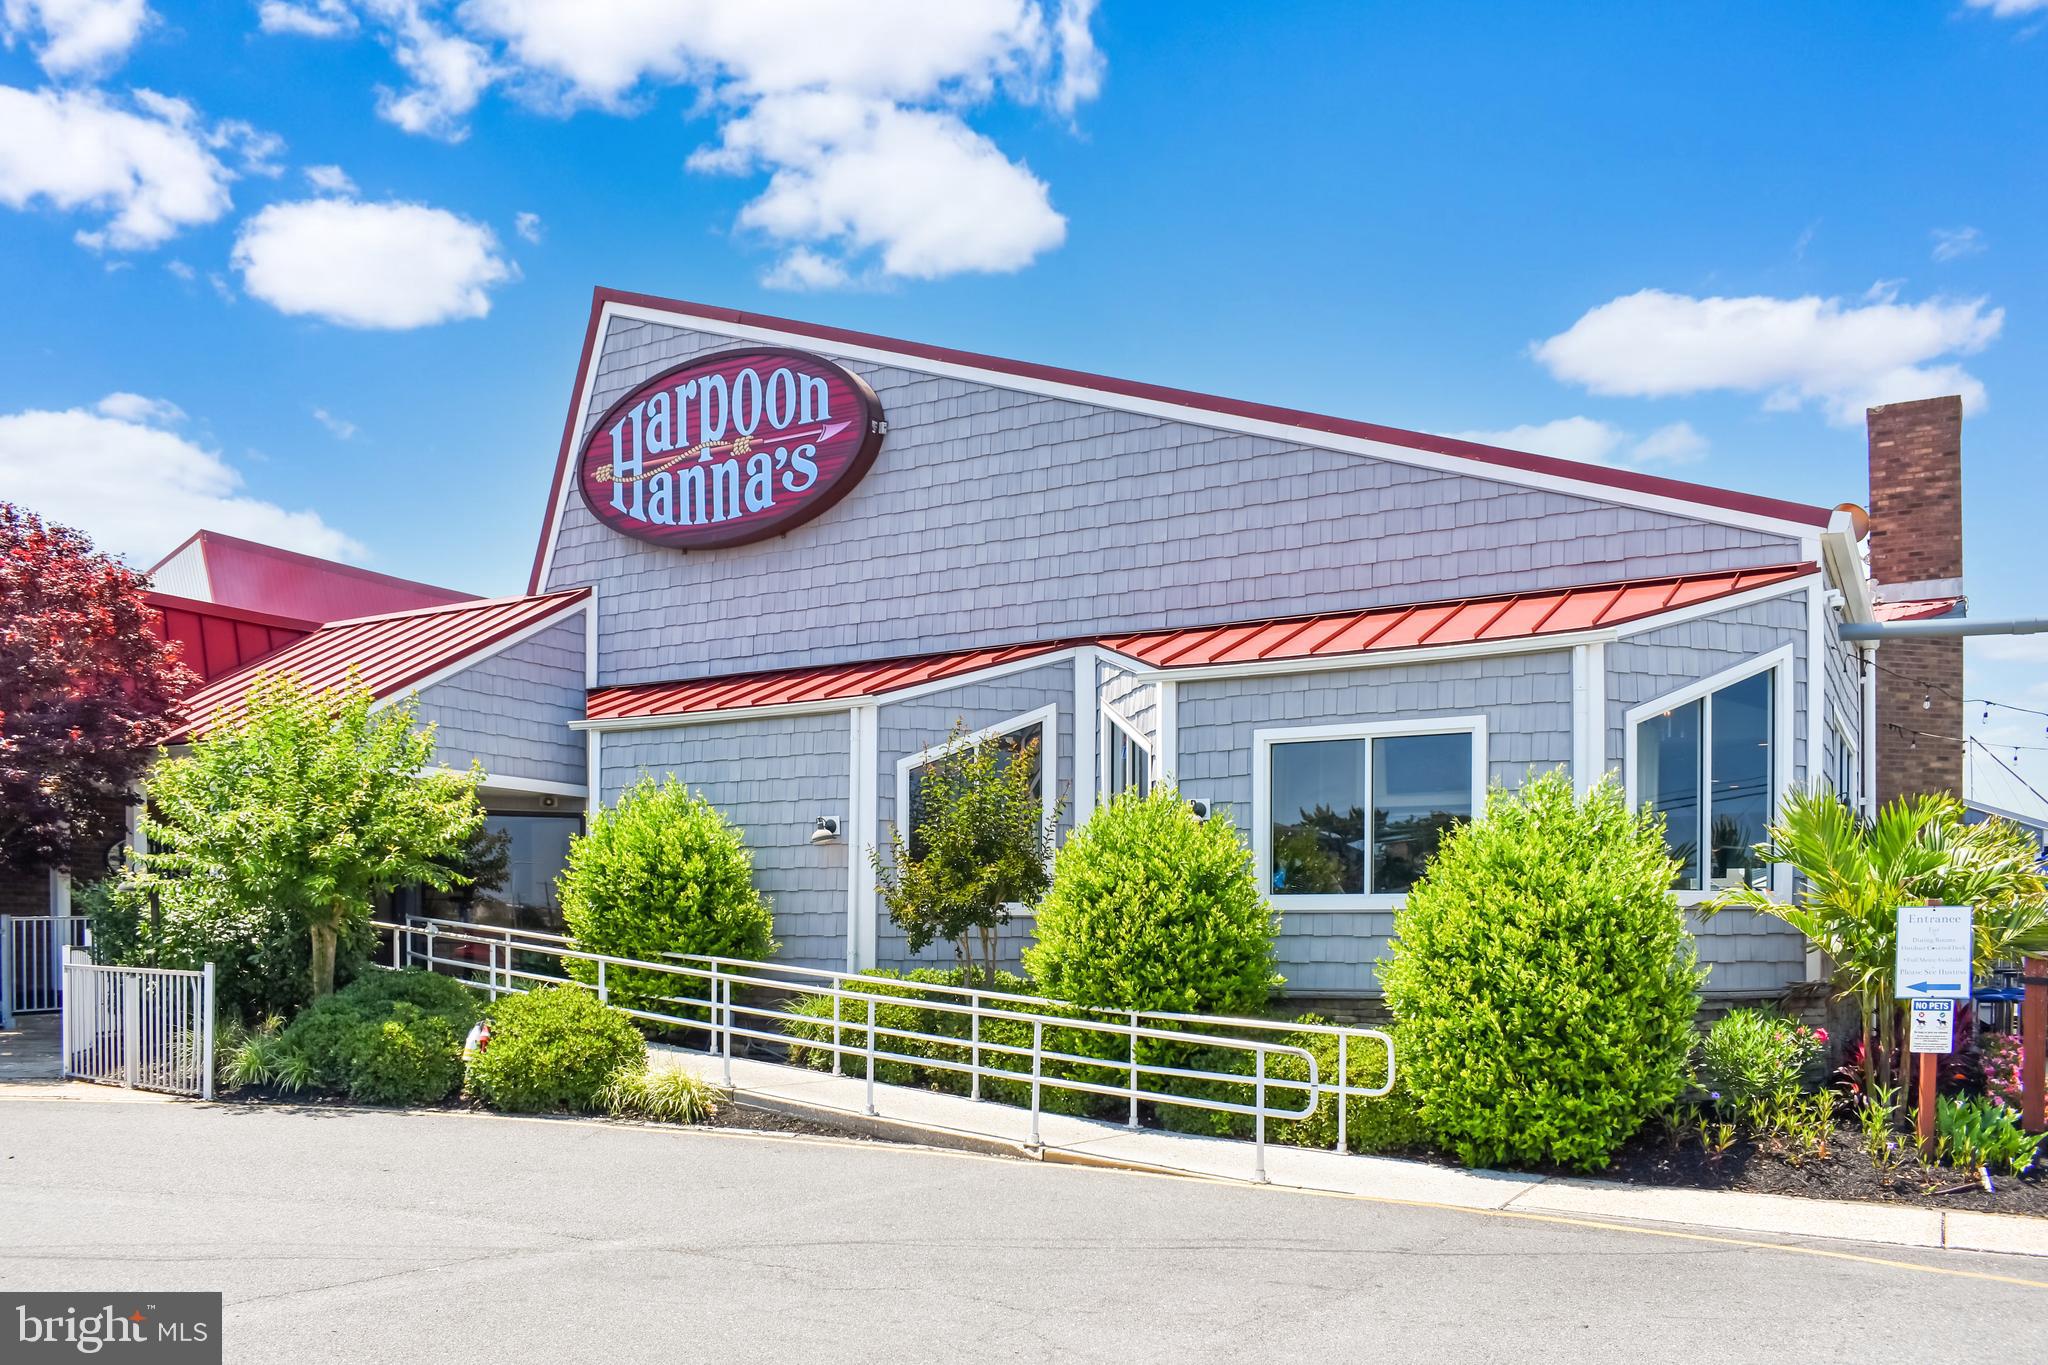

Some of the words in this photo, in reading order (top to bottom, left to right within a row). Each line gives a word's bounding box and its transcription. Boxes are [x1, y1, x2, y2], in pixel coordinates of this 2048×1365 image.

[609, 367, 832, 480] Harpoon
[609, 440, 818, 526] Hanna's
[1909, 914, 1961, 923] Entrance
[1915, 1002, 1928, 1010] NO
[1929, 1002, 1949, 1010] PETS
